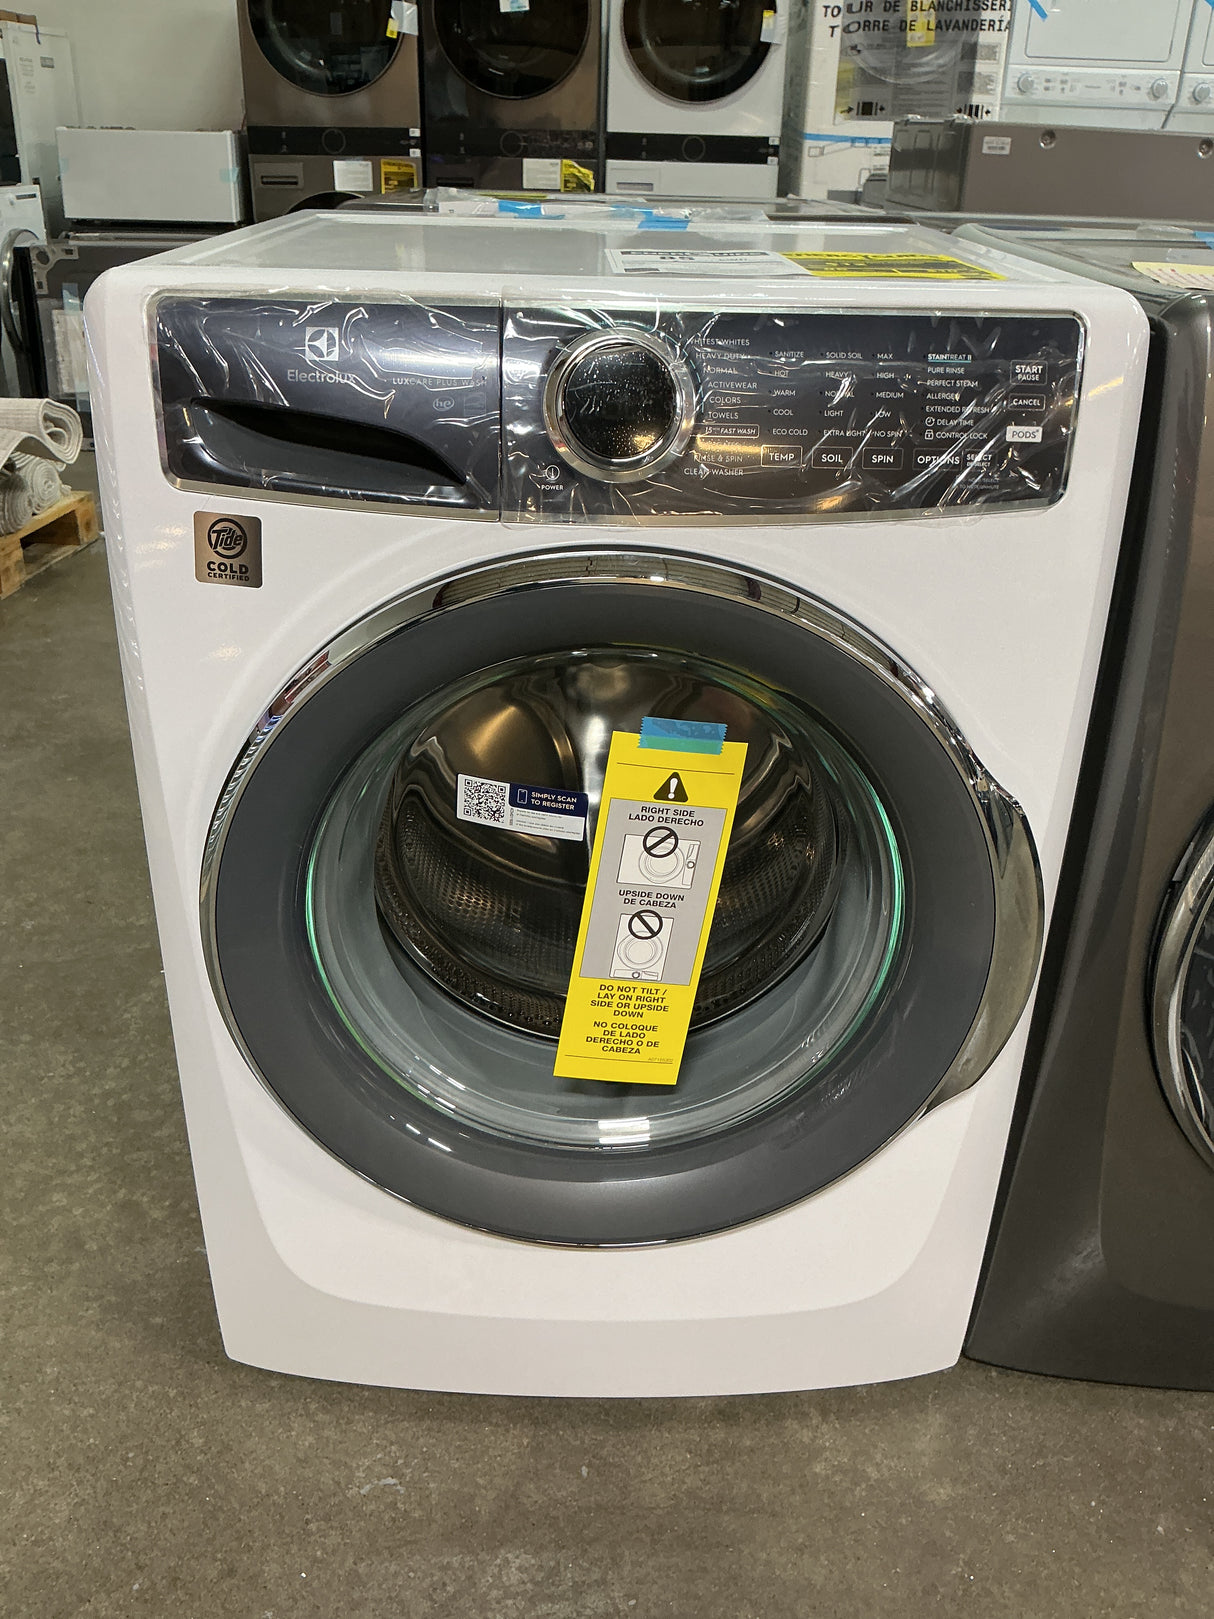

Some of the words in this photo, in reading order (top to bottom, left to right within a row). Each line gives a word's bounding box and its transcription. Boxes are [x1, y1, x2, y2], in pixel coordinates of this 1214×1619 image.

[883, 1, 900, 12] DE
[899, 20, 916, 32] DE
[695, 352, 722, 360] HEAVY
[774, 350, 805, 358] SANITIZE
[928, 353, 966, 361] STAINTREAT
[774, 370, 789, 378] HOT
[927, 366, 945, 374] PURE
[945, 367, 965, 375] RINSE
[1015, 365, 1044, 374] START
[287, 369, 356, 384] Electrolux
[392, 377, 433, 386] LUXCARE
[436, 379, 458, 387] PLUS
[708, 381, 758, 389] ACTIVEWEAR
[955, 380, 979, 388] STEAM
[774, 389, 796, 397] WARM
[876, 391, 904, 399] MEDIUM
[709, 396, 742, 404] COLORS
[708, 411, 739, 420] TOWELS
[773, 408, 793, 416] COOL
[959, 419, 974, 427] TIME
[772, 428, 788, 436] ECO
[788, 428, 808, 436] COLD
[823, 429, 844, 437] EXTRA
[969, 432, 988, 440] LOCK
[693, 455, 716, 463] RINSE
[726, 455, 743, 463] SPIN
[769, 453, 795, 462] TEMP
[821, 454, 843, 463] SOIL
[871, 455, 894, 463] SPIN
[710, 468, 744, 476] WASHER
[212, 527, 243, 550] Tide
[207, 561, 249, 574] COLD
[208, 572, 250, 581] CERTIFIED
[531, 792, 556, 801] SIMPLY
[543, 801, 574, 809] REGISTER
[641, 806, 671, 816] RIGHT
[672, 809, 695, 818] SIDE
[628, 813, 655, 823] LADO
[657, 816, 704, 827] DERECHO
[618, 889, 653, 899] UPSIDE
[655, 892, 685, 901] DOWN
[638, 899, 677, 909] CABEZA
[616, 985, 638, 994] NOT
[640, 987, 660, 995] TILT
[597, 992, 616, 1000] LAY
[635, 995, 666, 1004] RIGHT
[590, 1000, 613, 1008] SIDE
[633, 1003, 669, 1012] UPSIDE
[613, 1009, 644, 1018] DOWN
[610, 1022, 658, 1032] COLOQUE
[602, 1029, 617, 1037] DE
[619, 1031, 646, 1039] LADO
[585, 1036, 633, 1046] DERECHO
[601, 1045, 641, 1054] CABEZA
